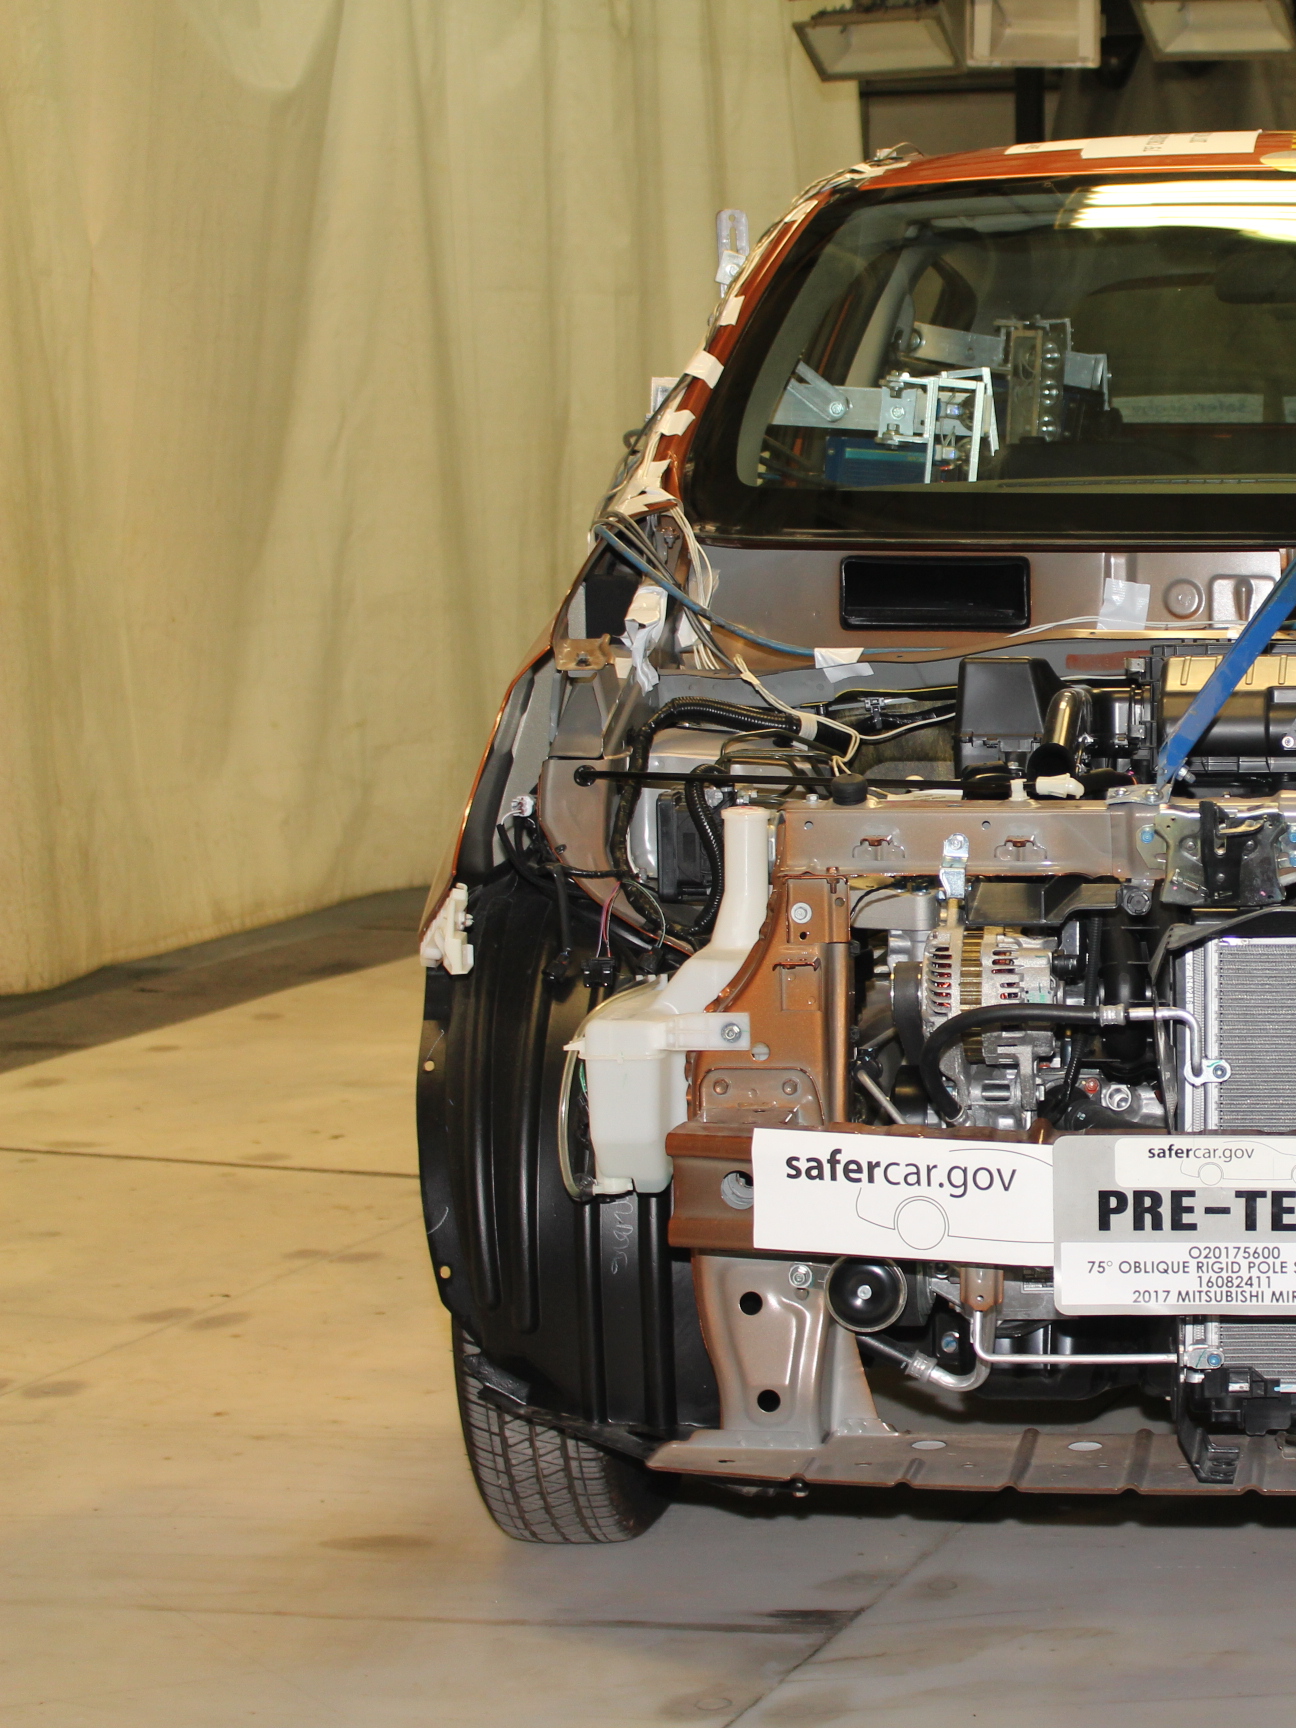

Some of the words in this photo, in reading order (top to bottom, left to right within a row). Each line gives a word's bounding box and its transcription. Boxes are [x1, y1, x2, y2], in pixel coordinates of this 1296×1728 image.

[1146, 1144, 1254, 1163] safercar.gov
[785, 1148, 1017, 1199] safercar.gov
[1087, 1260, 1114, 1275] 75°
[1118, 1260, 1190, 1276] OBLIQUE
[1196, 1260, 1242, 1275] RIGID
[1248, 1260, 1288, 1275] POLE
[1197, 1275, 1272, 1289] 16082411
[1132, 1289, 1171, 1304] 2017
[1177, 1289, 1265, 1304] MITSUBISHI
